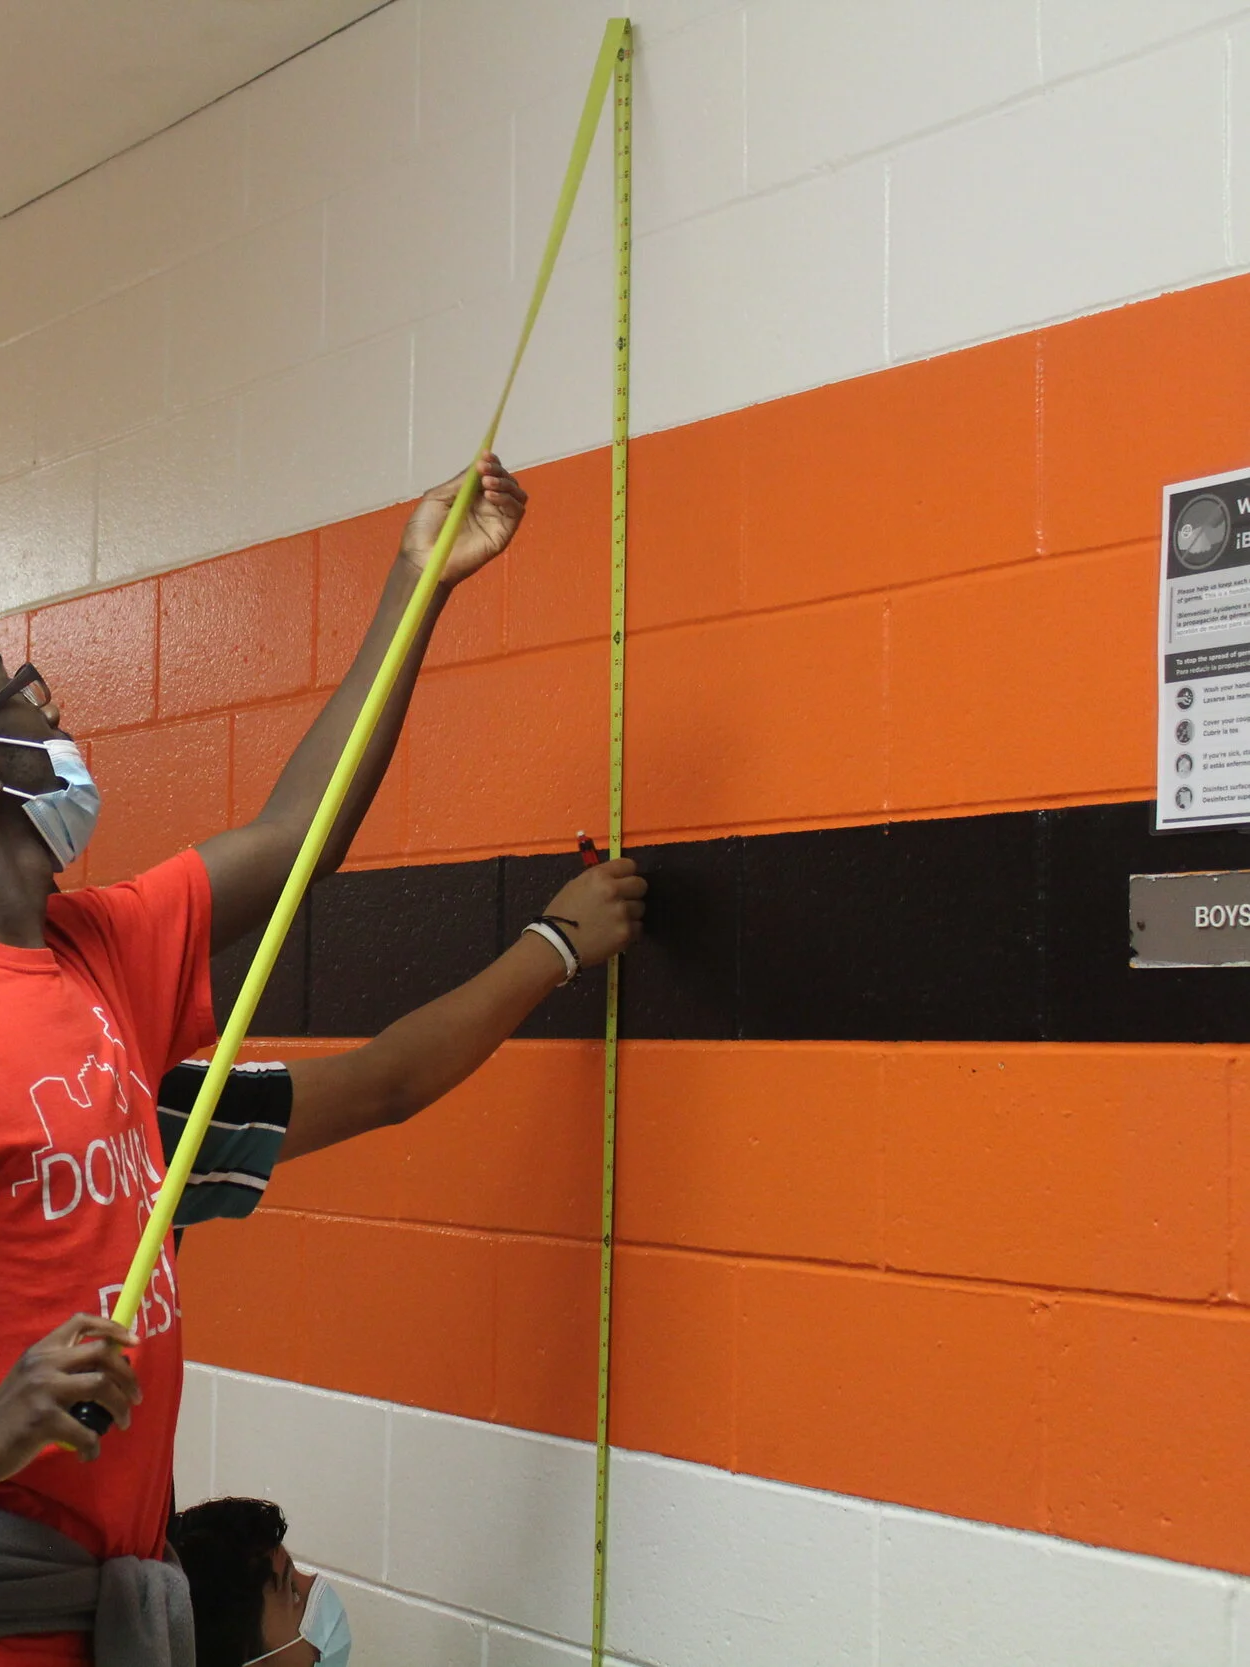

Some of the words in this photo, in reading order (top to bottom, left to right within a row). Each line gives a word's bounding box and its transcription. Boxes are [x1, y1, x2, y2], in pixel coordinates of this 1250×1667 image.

[1175, 658, 1184, 666] To
[1184, 656, 1197, 665] stop
[1197, 654, 1208, 662] the
[1209, 651, 1229, 661] spread
[1230, 649, 1237, 658] of
[1203, 719, 1220, 727] Cover
[1221, 718, 1235, 726] your
[1203, 729, 1221, 737] Cubrir
[1203, 785, 1229, 793] Disinfect
[1195, 904, 1250, 928] BOYS
